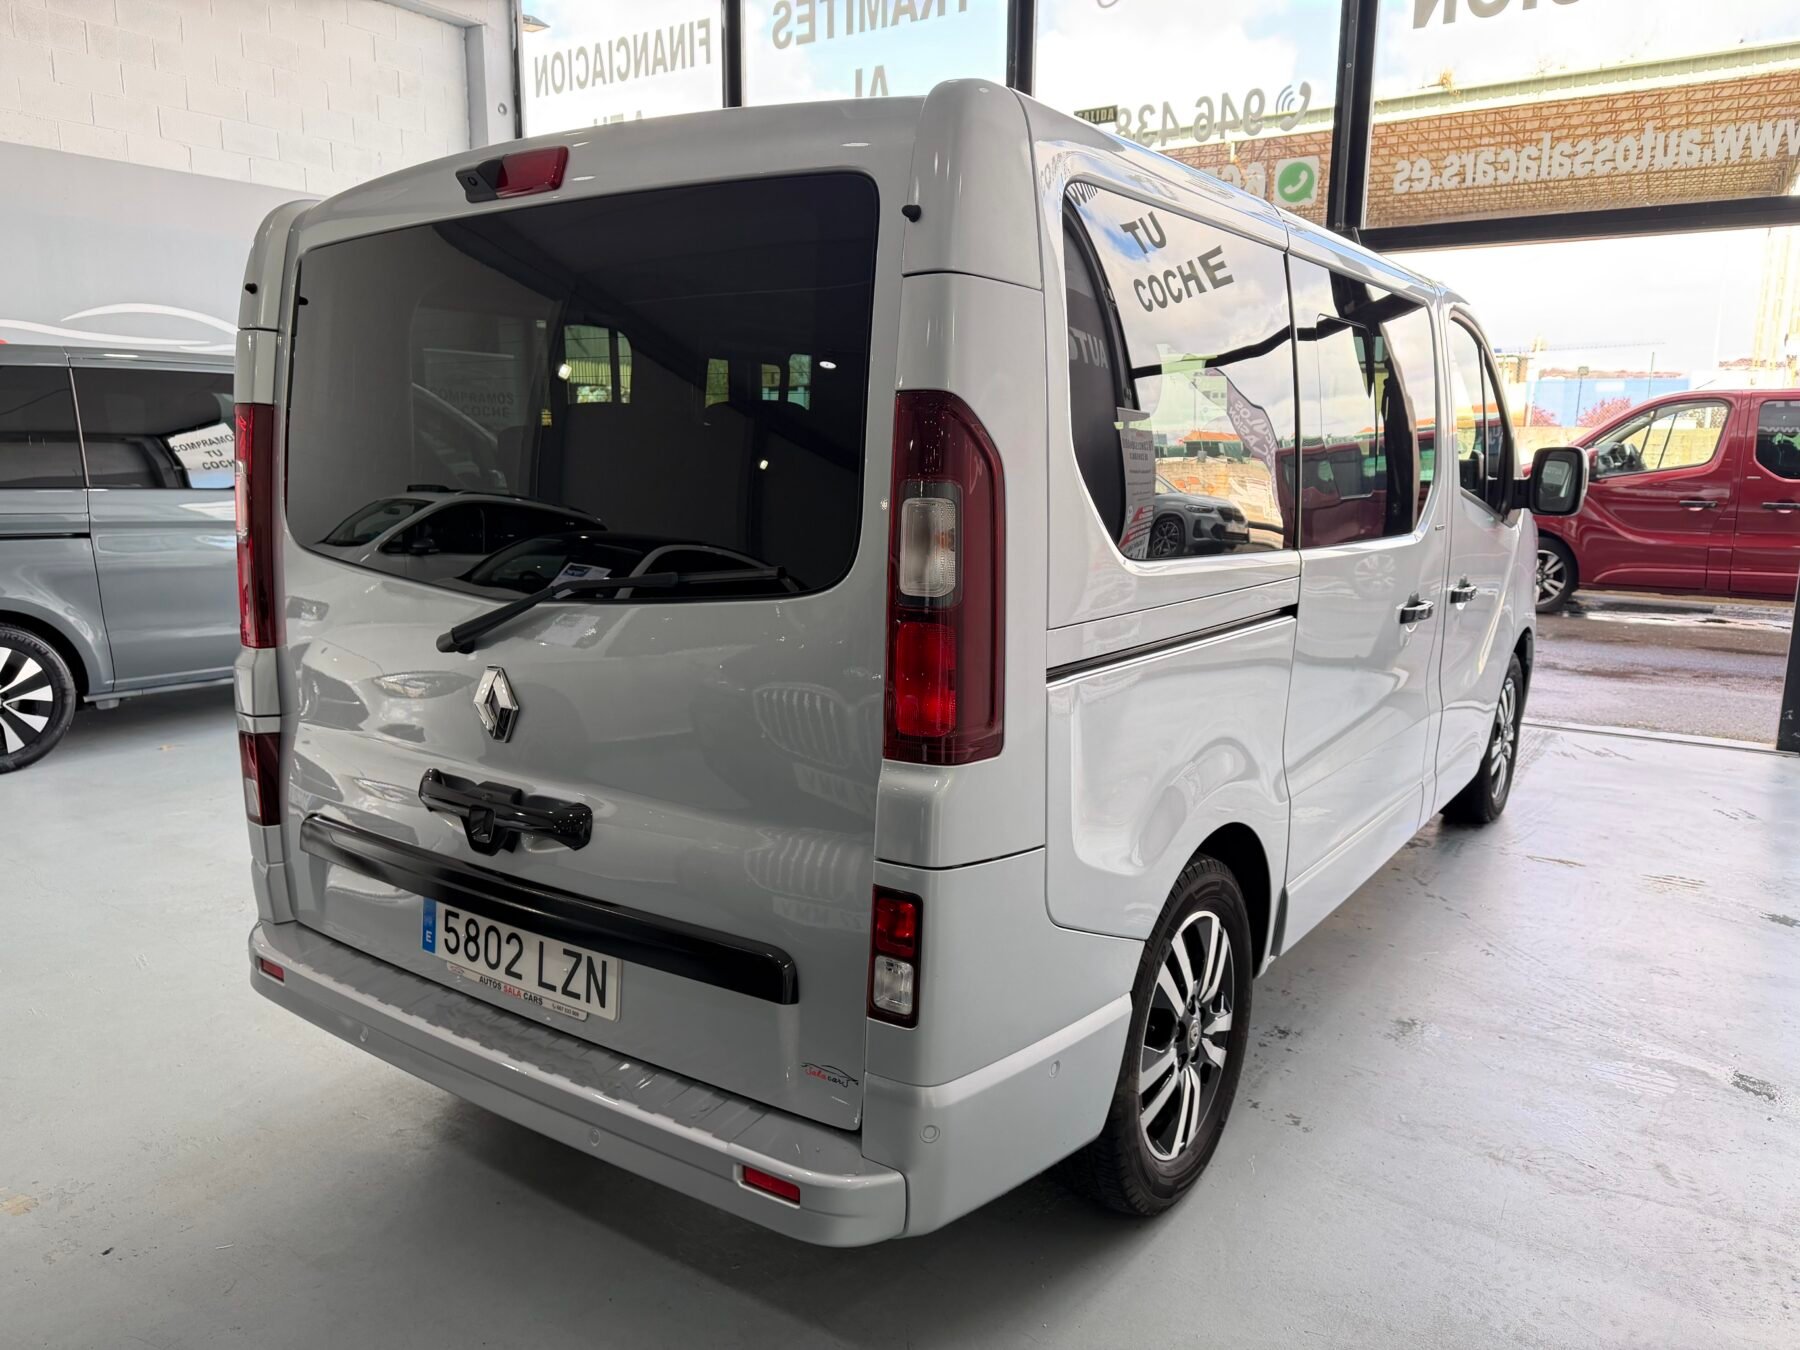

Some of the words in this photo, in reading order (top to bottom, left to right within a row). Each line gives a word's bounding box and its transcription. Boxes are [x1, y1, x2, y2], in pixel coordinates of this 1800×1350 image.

[1120, 211, 1167, 254] TU
[1133, 245, 1235, 313] COCHE
[173, 433, 235, 453] COMPRAMO
[204, 449, 223, 458] TU
[425, 929, 433, 943] E
[443, 909, 524, 980] 5802
[538, 940, 608, 1010] LZN
[479, 975, 502, 991] AUTOS
[503, 984, 522, 998] SALA
[523, 992, 543, 1006] CARS
